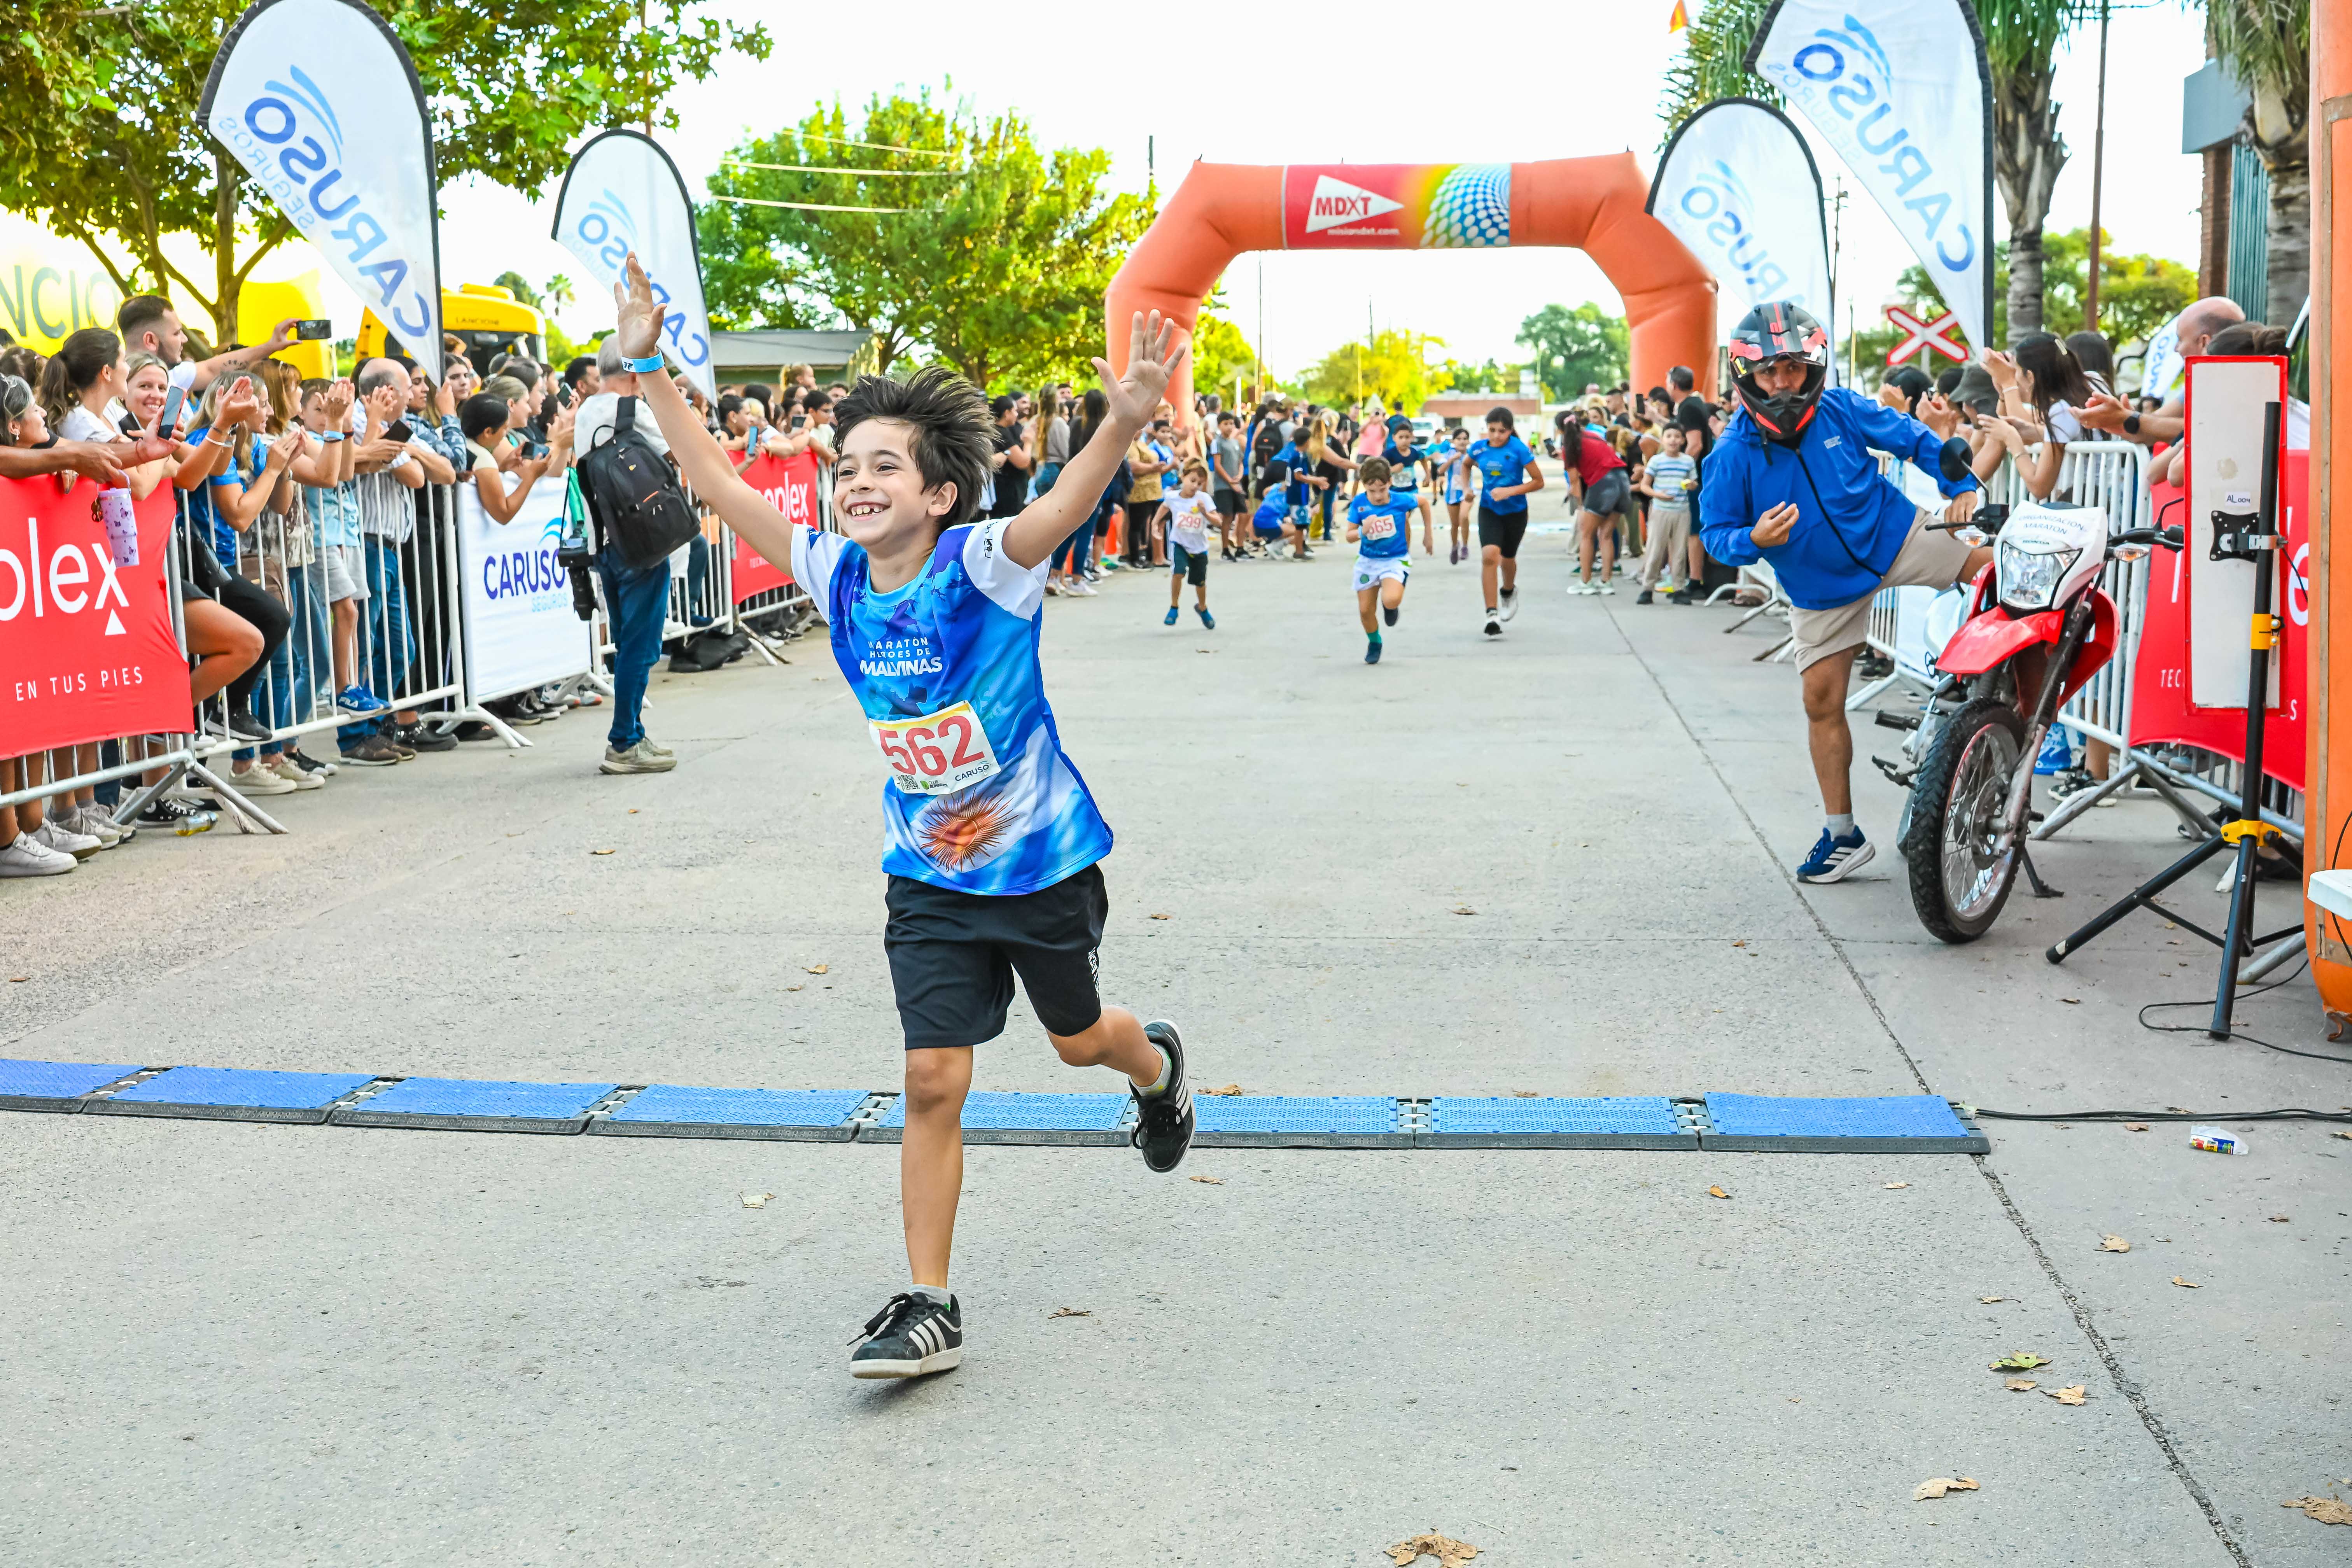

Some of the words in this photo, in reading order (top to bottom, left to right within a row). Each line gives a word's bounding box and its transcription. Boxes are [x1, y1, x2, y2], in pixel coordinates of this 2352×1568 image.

[1316, 191, 1371, 215] MDXT
[1177, 513, 1201, 529] 299
[484, 548, 565, 600] CARUSO
[917, 648, 931, 656] DE
[859, 656, 943, 677] MALVINAS
[16, 681, 37, 702] EN
[49, 673, 87, 695] TUS
[101, 666, 143, 688] PIES
[878, 716, 985, 776] 562
[955, 764, 989, 782] CARUSO
